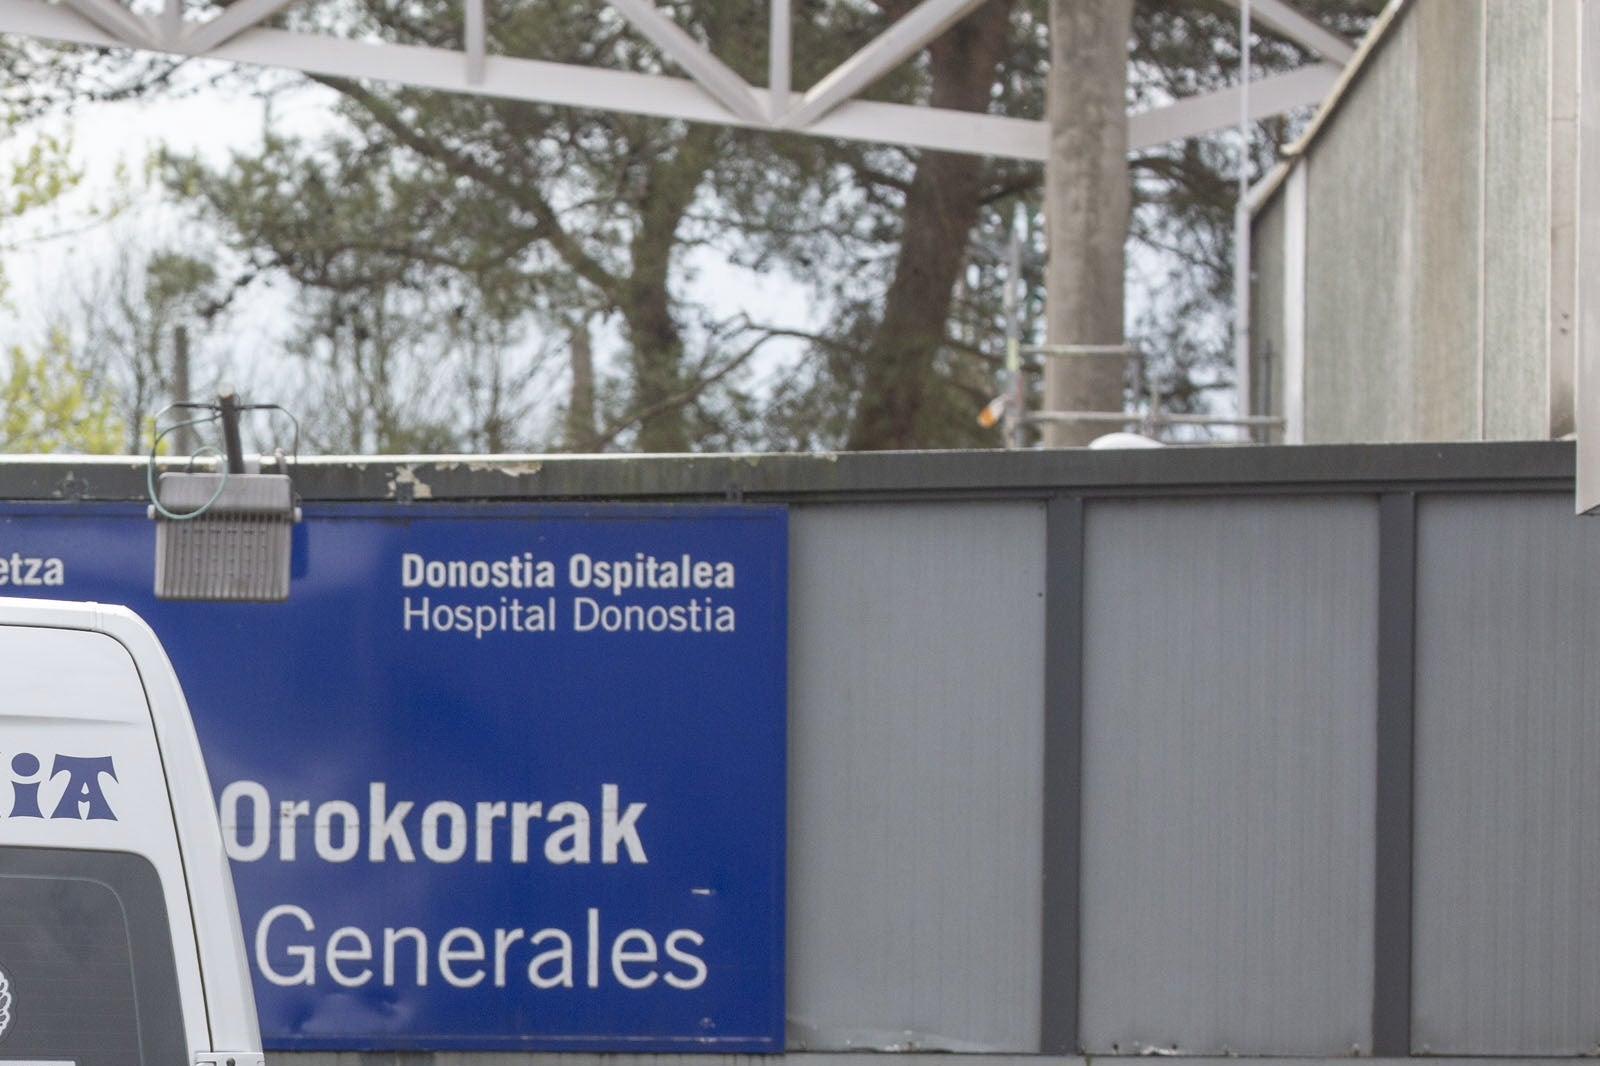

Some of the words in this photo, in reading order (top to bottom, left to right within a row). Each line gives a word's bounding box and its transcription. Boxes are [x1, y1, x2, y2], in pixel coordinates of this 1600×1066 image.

[402, 552, 555, 588] Donostia
[569, 552, 735, 596] Ospitalea
[404, 597, 556, 639] Hospital
[574, 597, 736, 632] Donostia
[220, 780, 648, 864] Orokorrak
[255, 904, 708, 990] Generales
